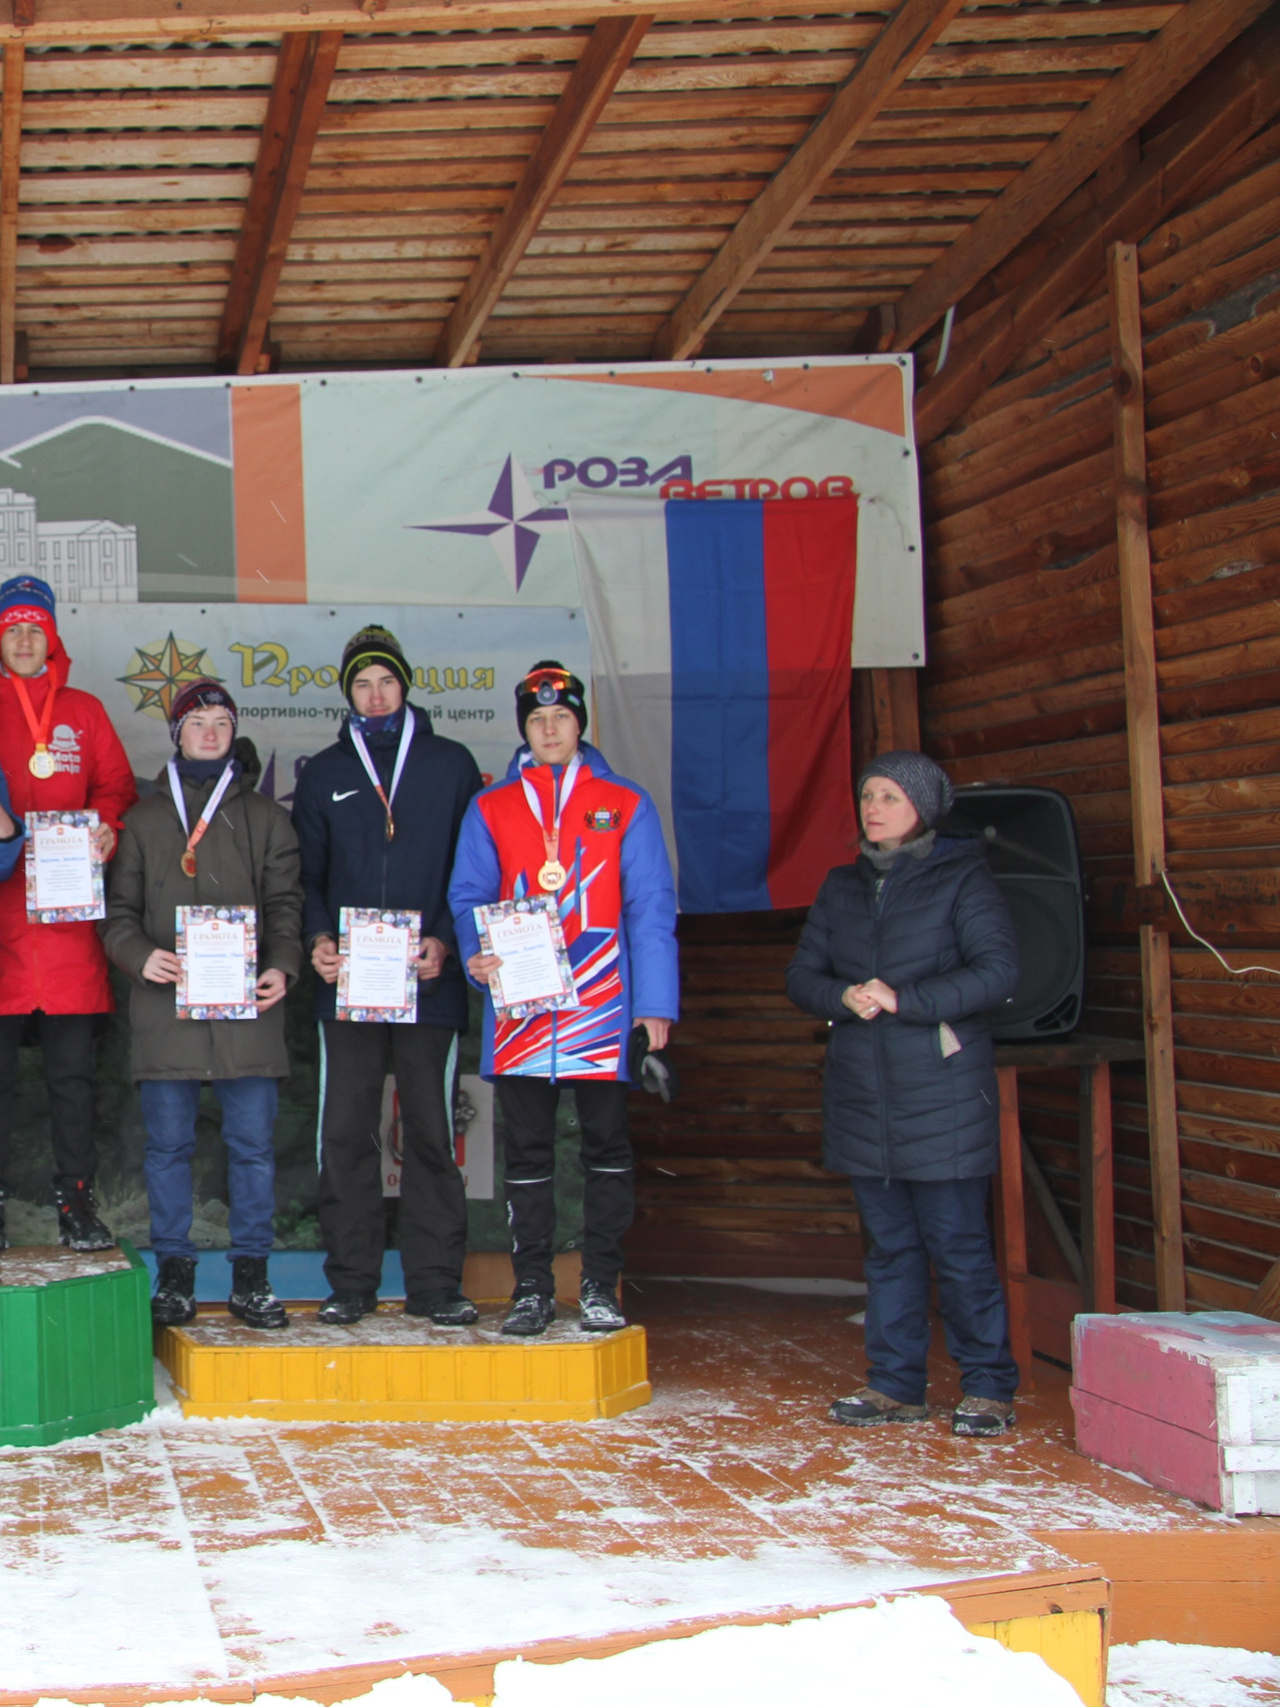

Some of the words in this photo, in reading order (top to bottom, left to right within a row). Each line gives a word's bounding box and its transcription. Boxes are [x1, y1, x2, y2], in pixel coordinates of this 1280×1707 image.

[543, 455, 692, 489] РОЗА
[228, 641, 495, 696] Проция
[448, 707, 495, 723] центр
